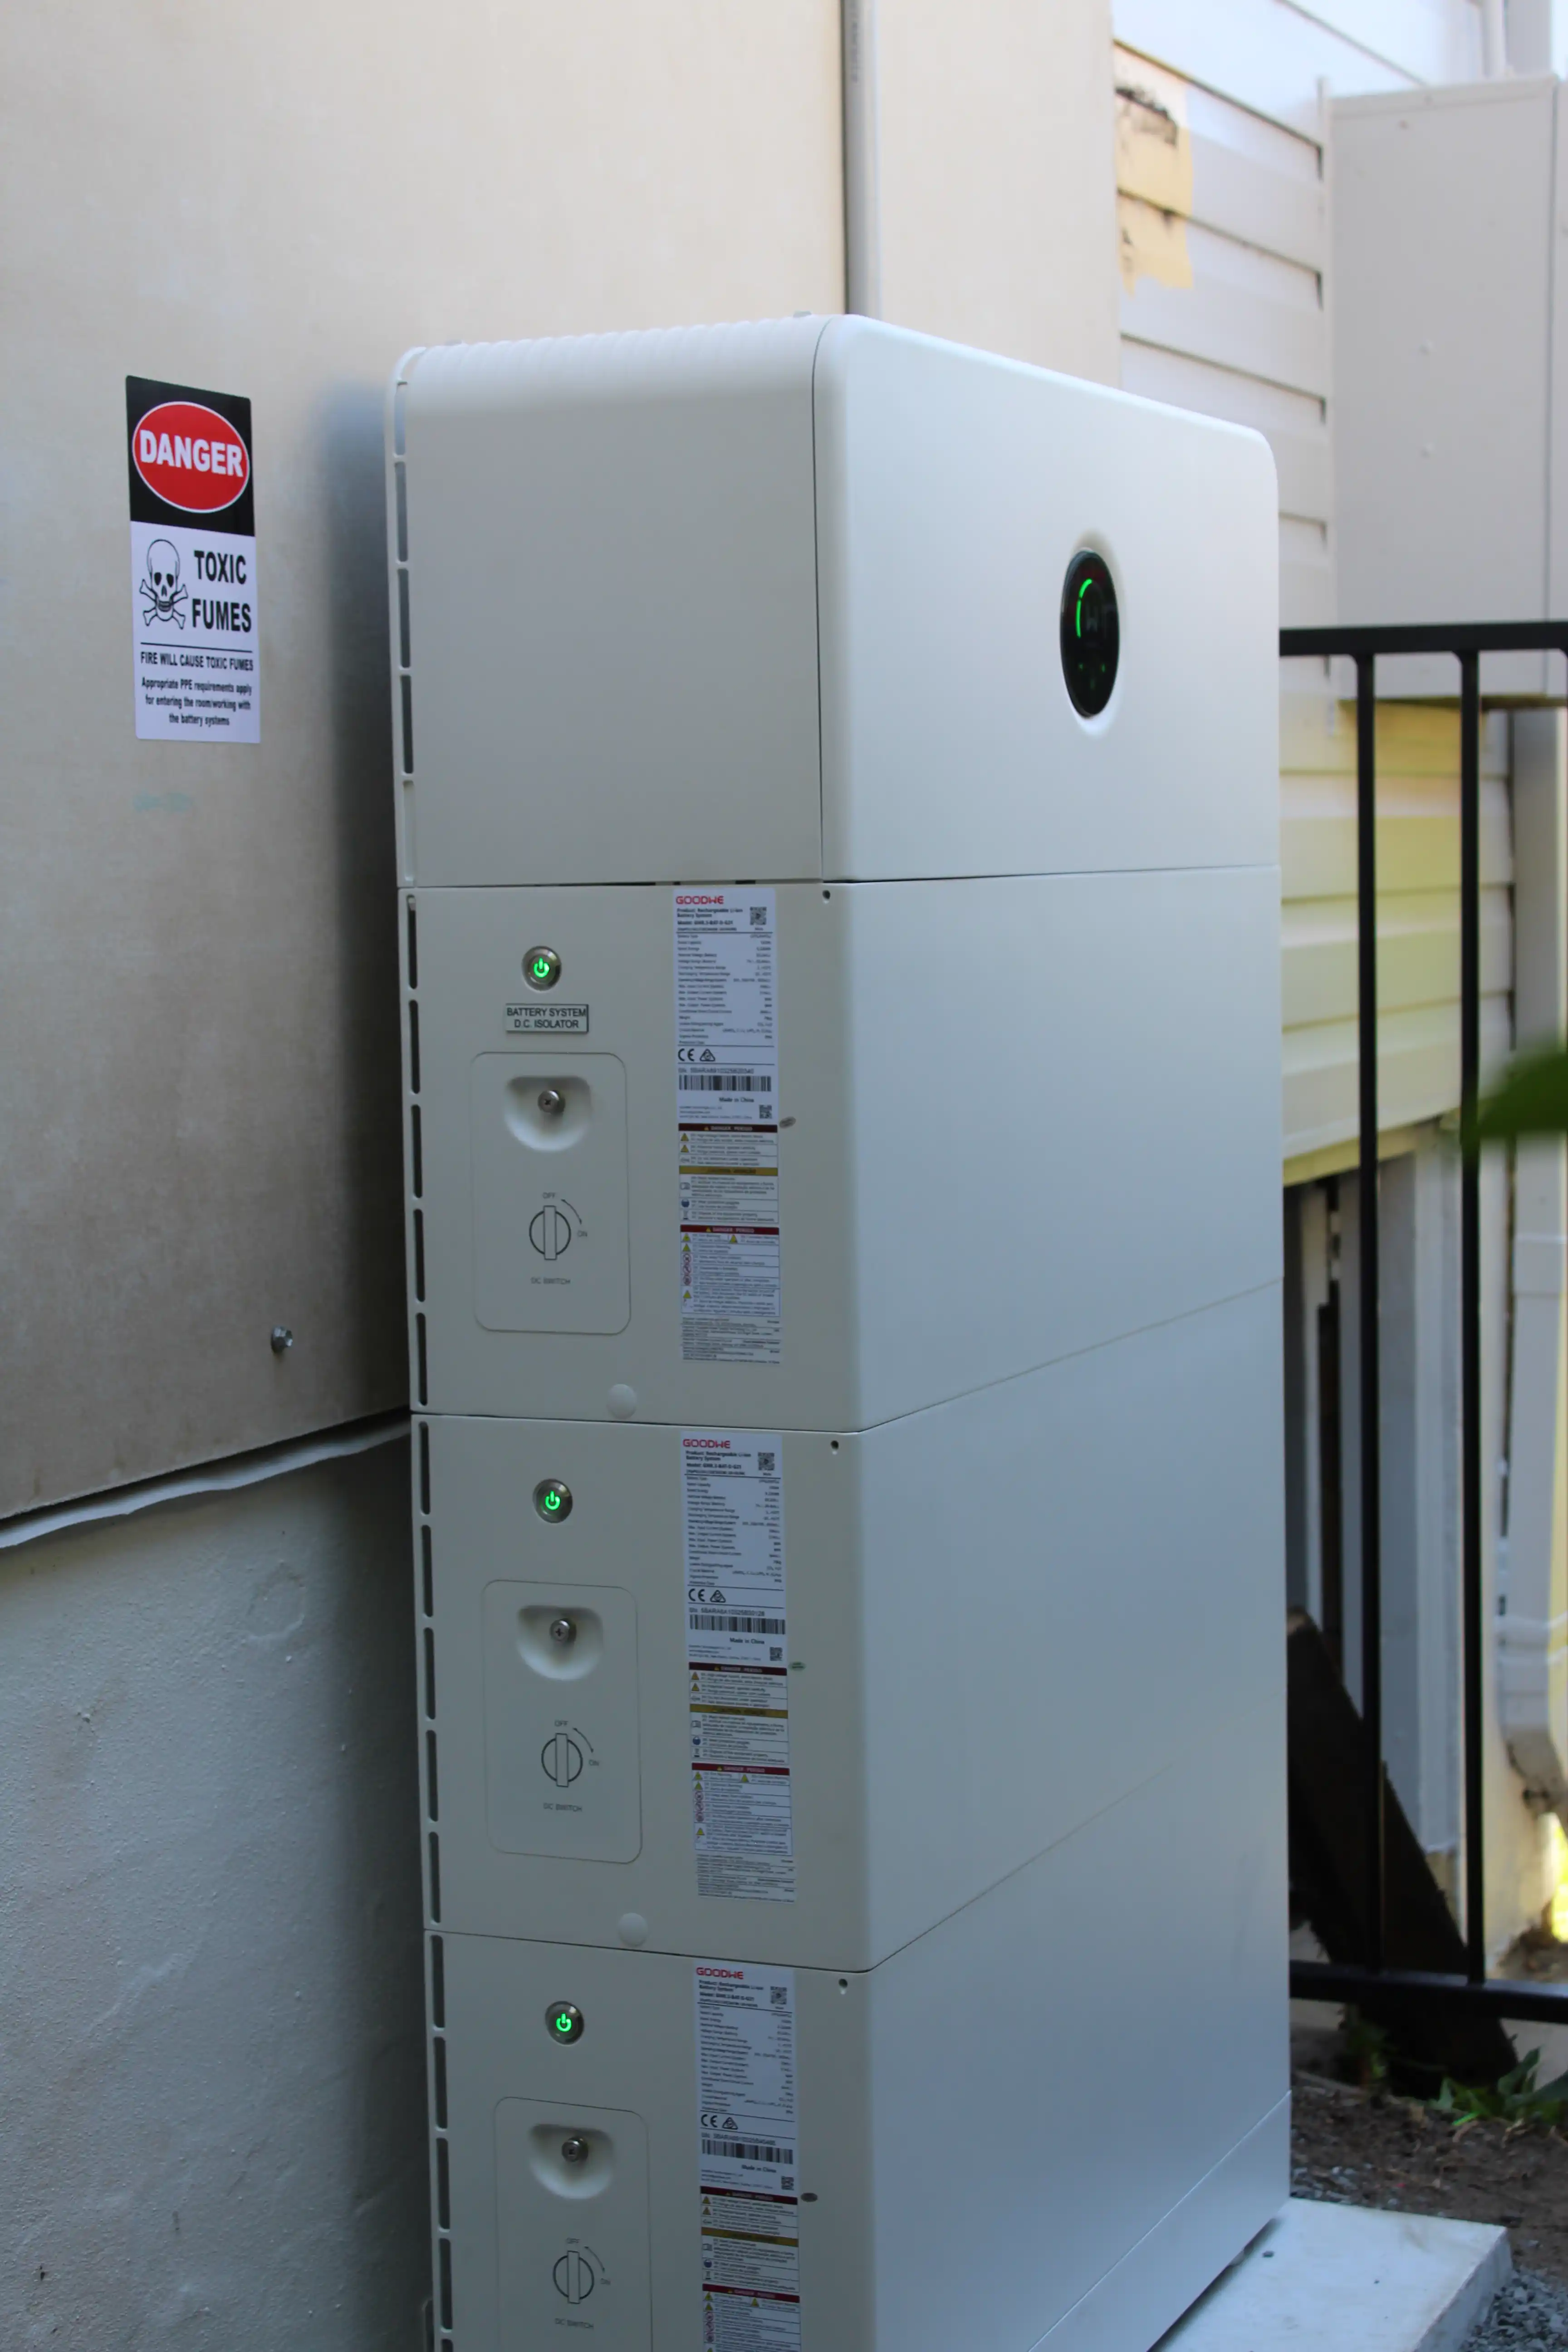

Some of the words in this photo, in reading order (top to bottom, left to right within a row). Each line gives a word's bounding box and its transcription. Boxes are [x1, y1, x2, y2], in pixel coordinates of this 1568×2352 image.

[140, 429, 244, 477] DANGER
[194, 550, 247, 585] TOXIC
[192, 598, 252, 633] FUMES
[141, 652, 158, 664] FIRE
[160, 653, 178, 666] WILL
[180, 654, 204, 667] CAUSE
[206, 656, 227, 669] TOXIC
[230, 658, 254, 671] FUMES
[142, 676, 178, 691] Appropriate
[181, 679, 193, 690] PPE
[194, 680, 234, 693] requirements
[236, 684, 252, 696] apply
[146, 693, 155, 705] for
[156, 695, 182, 710] entering
[184, 696, 194, 707] the
[238, 699, 251, 710] with
[169, 713, 179, 723] the
[181, 713, 203, 727] battery
[205, 715, 230, 727] systems
[676, 896, 725, 905] GOODWE
[507, 1008, 548, 1016] BATTERY
[549, 1008, 586, 1016] SYSTEM
[534, 1019, 579, 1028] ISOLATOR
[683, 1439, 730, 1449] GOODWE
[696, 1967, 744, 1980] GOODWE
